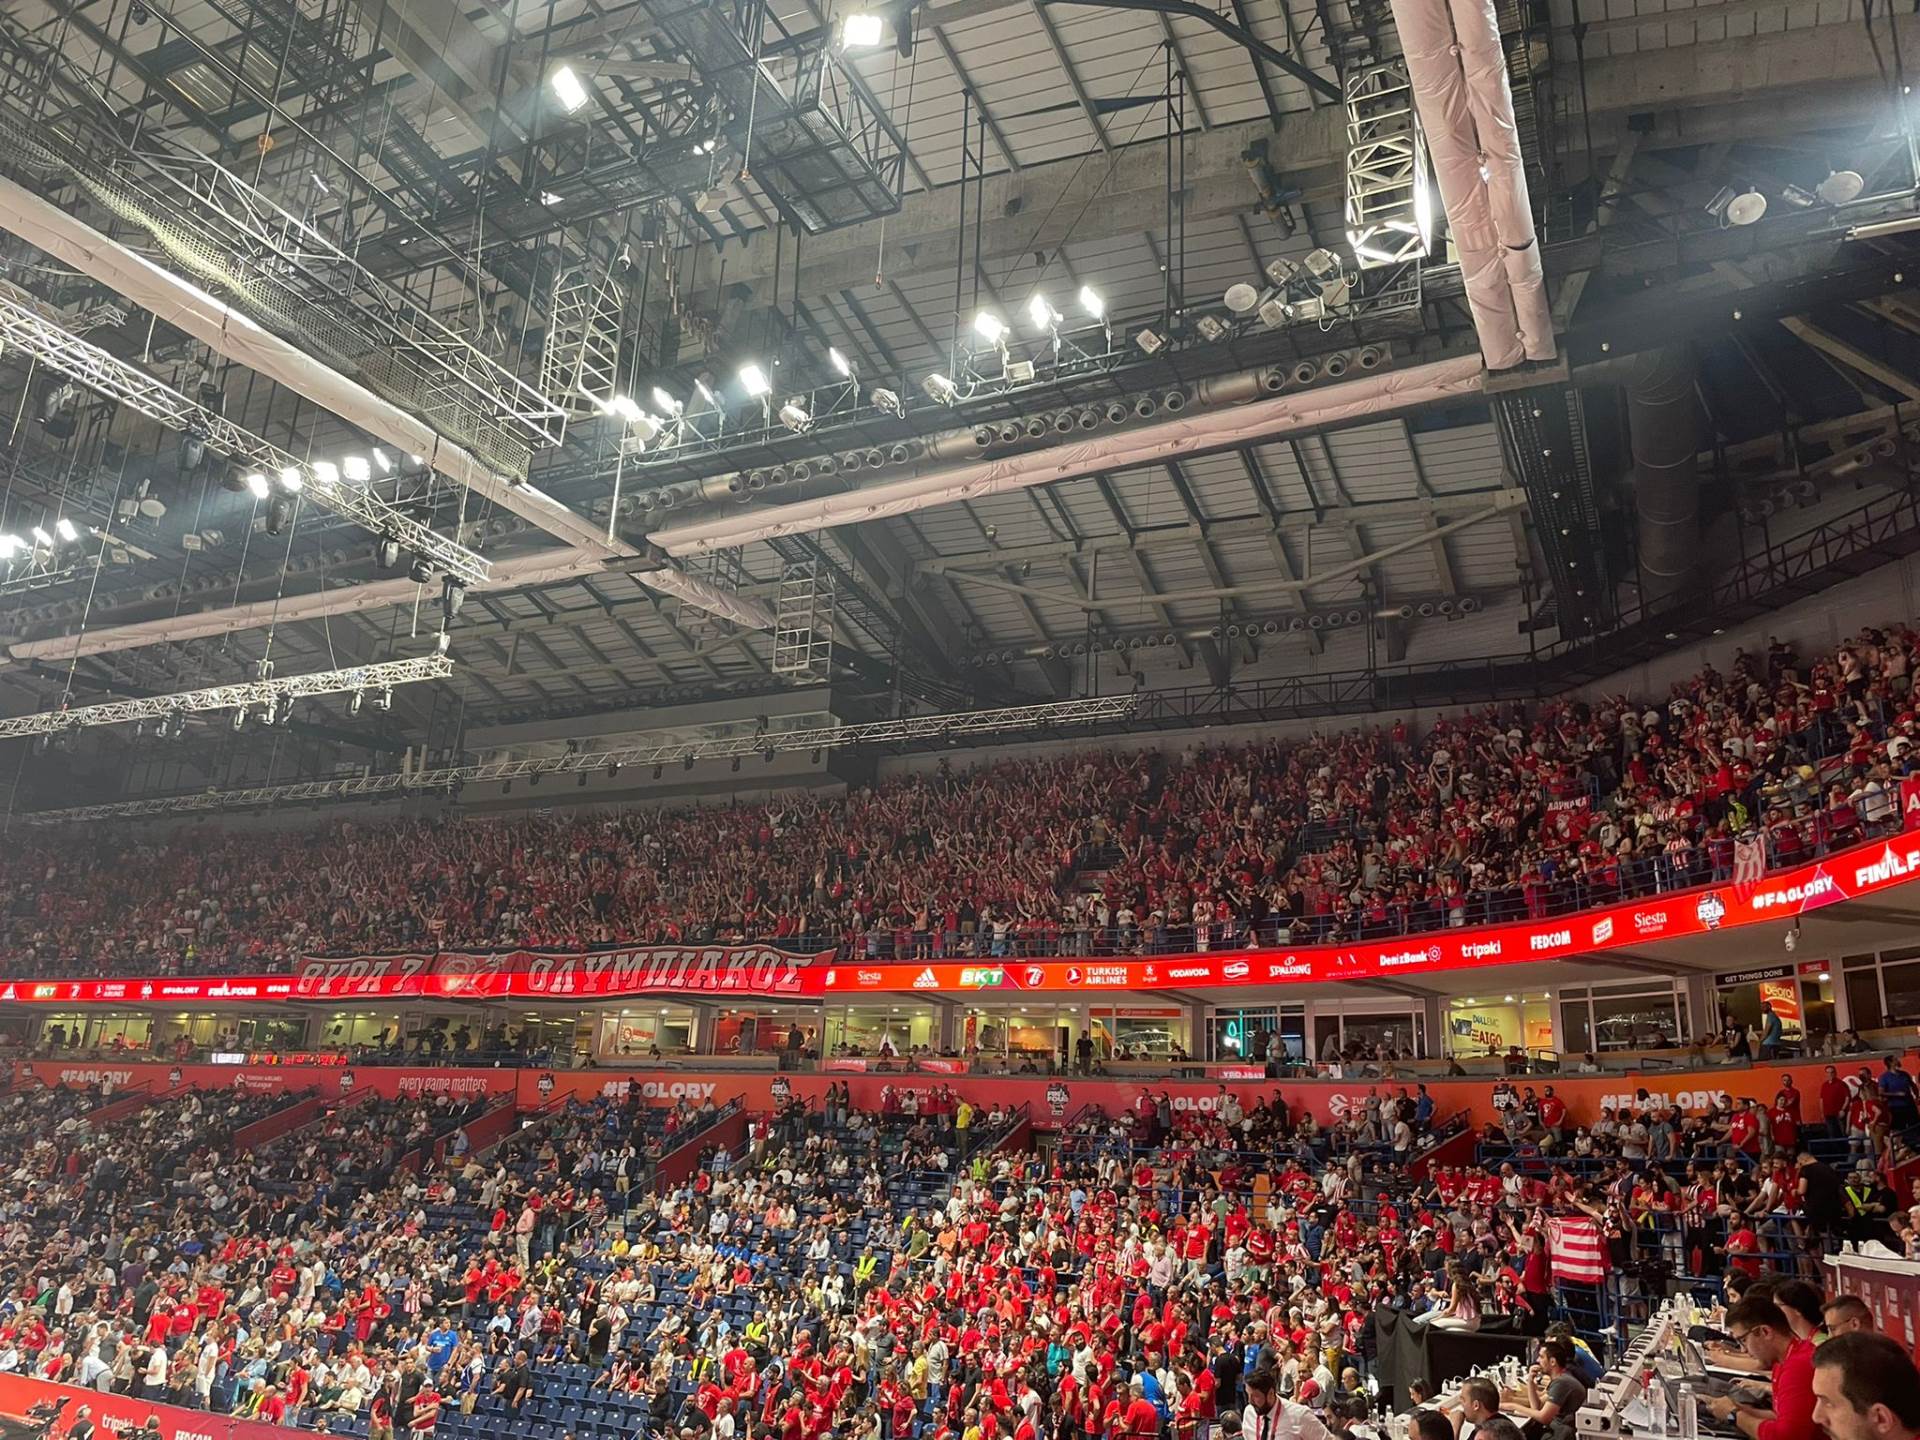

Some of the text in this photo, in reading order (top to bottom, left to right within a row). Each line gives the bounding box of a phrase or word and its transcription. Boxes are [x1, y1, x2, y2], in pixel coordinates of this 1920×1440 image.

[1752, 876, 1833, 909] #F4GLORY
[1634, 912, 1667, 928] Siesta
[1530, 930, 1571, 950] FEDCOM
[1379, 951, 1428, 967] DenizBank
[527, 949, 812, 993] ΟΛΥΜΠΙΑΚΟΣ
[960, 969, 1003, 985] BKT
[1086, 967, 1127, 976] TURKISH
[1269, 963, 1312, 977] SPALDING
[1086, 976, 1127, 985] AIRLINES
[399, 1077, 488, 1093] every game matters
[603, 1082, 717, 1098] #FGLORY
